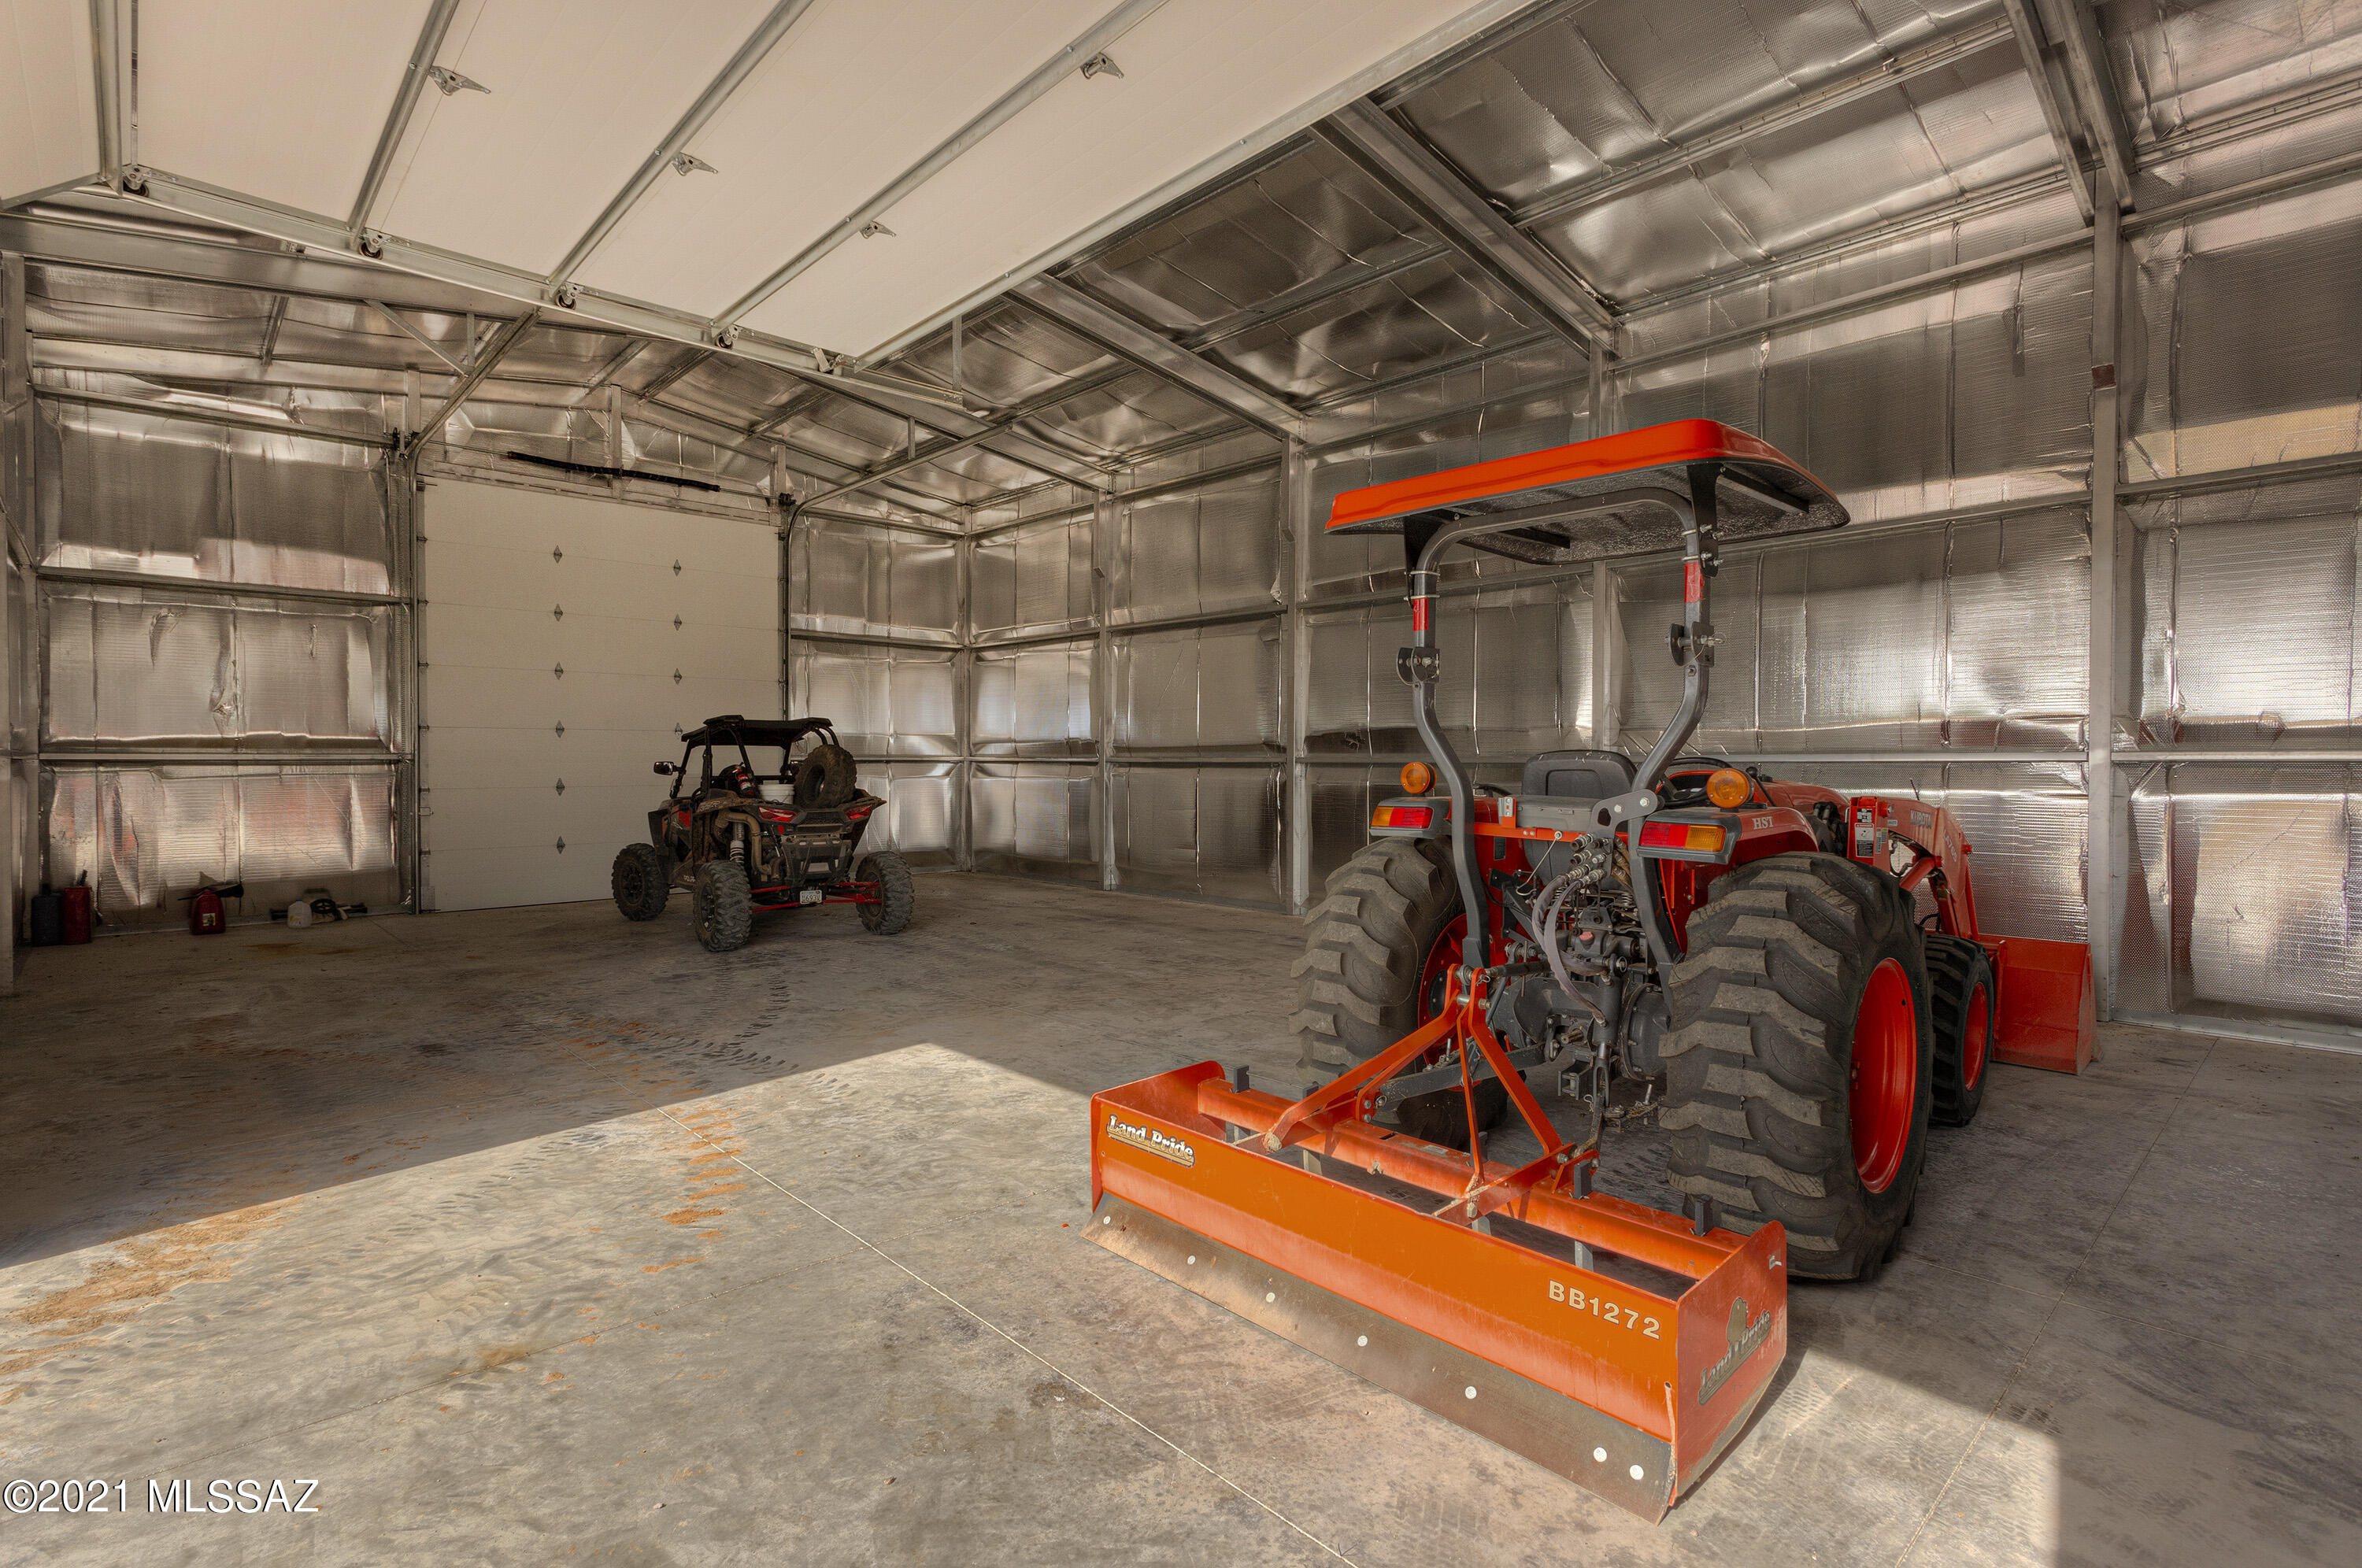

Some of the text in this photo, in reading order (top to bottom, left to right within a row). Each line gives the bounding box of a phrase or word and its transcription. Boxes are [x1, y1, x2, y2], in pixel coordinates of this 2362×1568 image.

[1752, 816, 1774, 830] HST
[1107, 1115, 1194, 1159] Land Pride
[1548, 1279, 1660, 1341] BB1272
